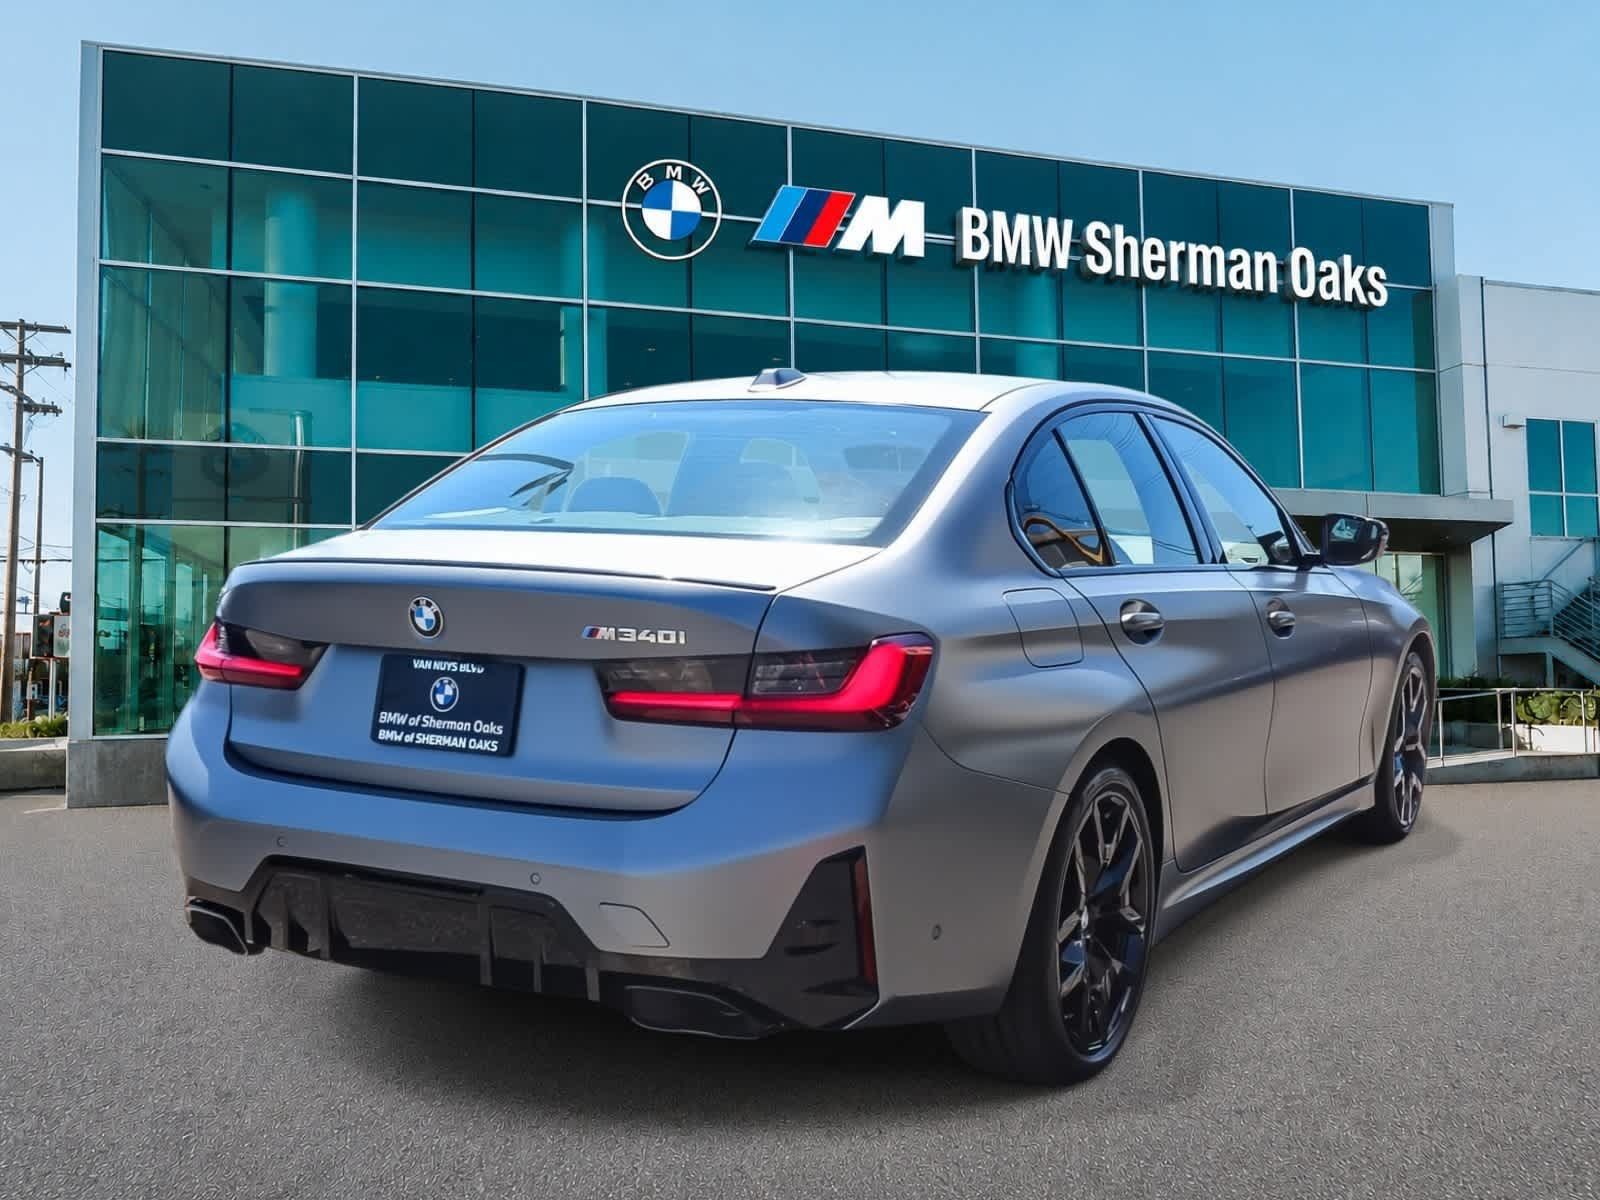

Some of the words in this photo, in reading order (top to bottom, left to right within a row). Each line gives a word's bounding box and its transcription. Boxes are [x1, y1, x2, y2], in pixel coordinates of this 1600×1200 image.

[636, 164, 711, 196] BMW
[835, 194, 925, 258] M
[961, 206, 1074, 270] BMW
[1085, 220, 1279, 294] Sherman
[1289, 247, 1389, 308] Oaks
[413, 658, 433, 670] VAN
[432, 660, 459, 672] NUYS
[378, 711, 407, 724] BMW
[408, 714, 422, 727] of
[421, 715, 471, 732] Sherman
[473, 720, 504, 735] Oaks
[378, 729, 404, 741] BMW
[404, 732, 416, 743] of
[415, 733, 467, 749] SHERMAN
[468, 738, 499, 752] OAKS
